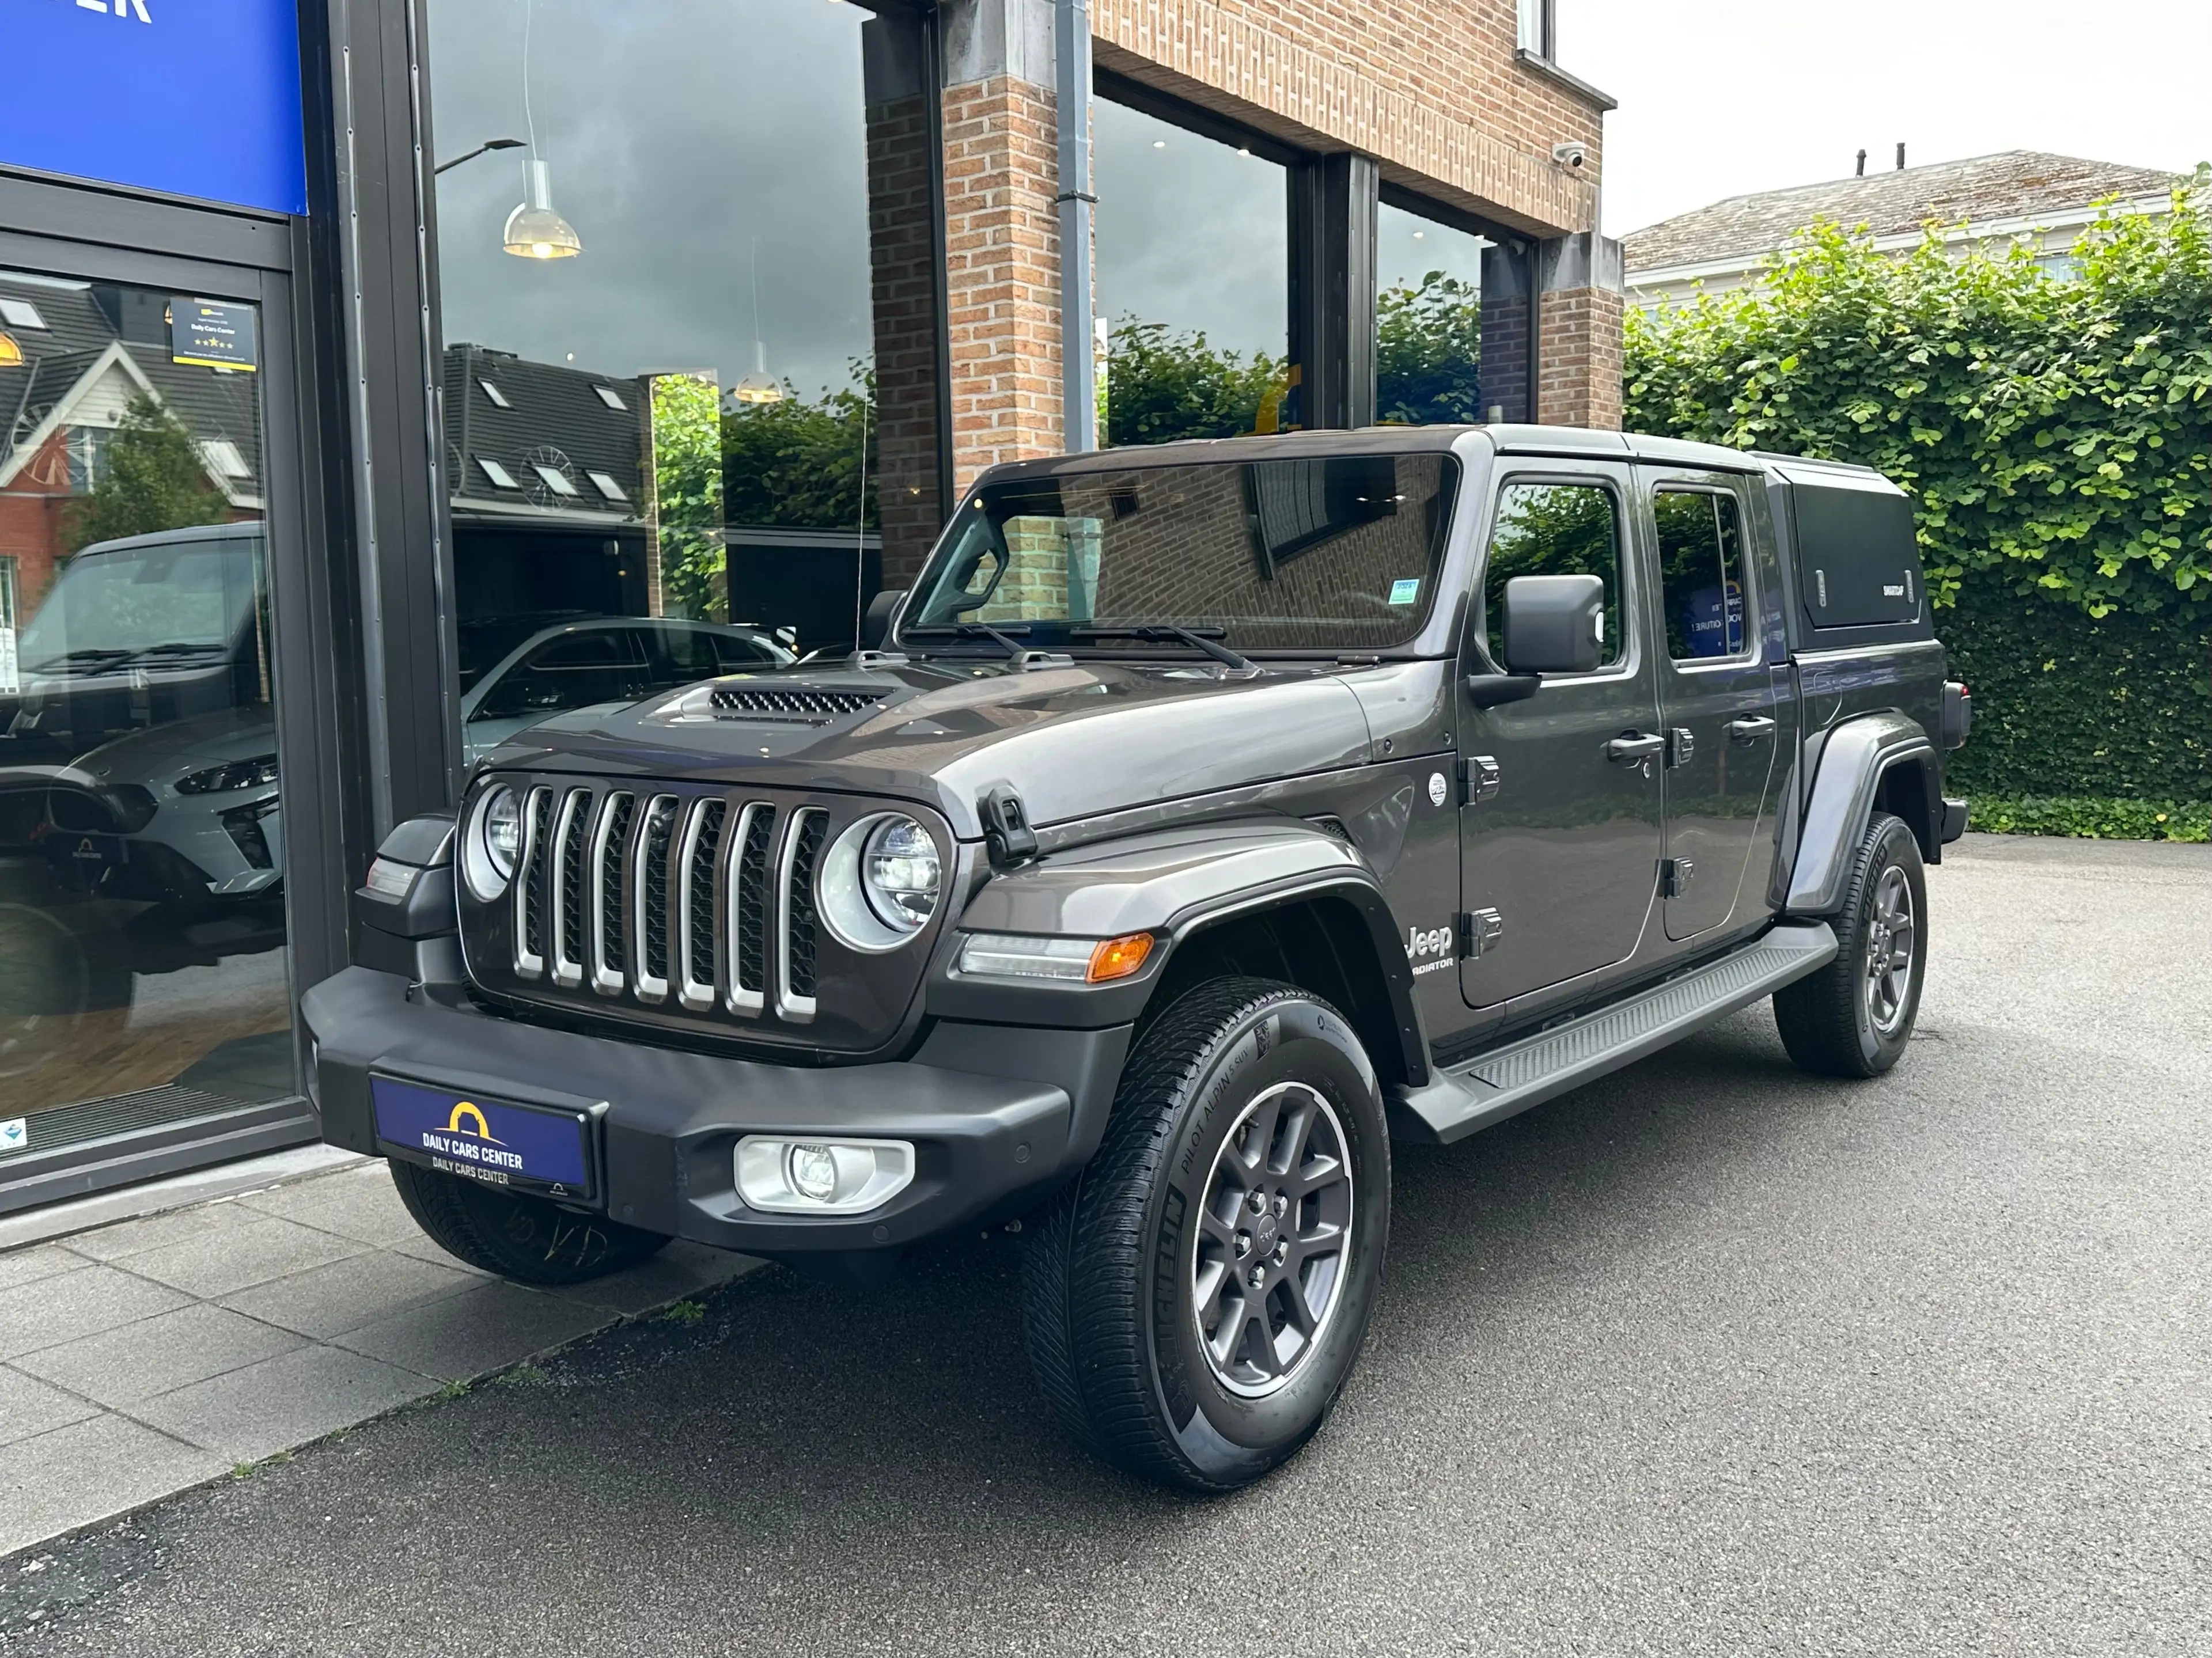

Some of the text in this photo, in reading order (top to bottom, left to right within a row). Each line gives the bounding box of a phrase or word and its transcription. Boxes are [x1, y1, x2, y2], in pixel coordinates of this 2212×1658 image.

[1404, 927, 1452, 959] Jeep
[1412, 958, 1453, 976] ADIATOR
[1181, 1120, 1205, 1175] PILOT
[1203, 1072, 1231, 1120] ALPIN
[422, 1133, 523, 1170] DAILY CARS CENTER
[433, 1156, 509, 1185] DAILY CARS CENTER
